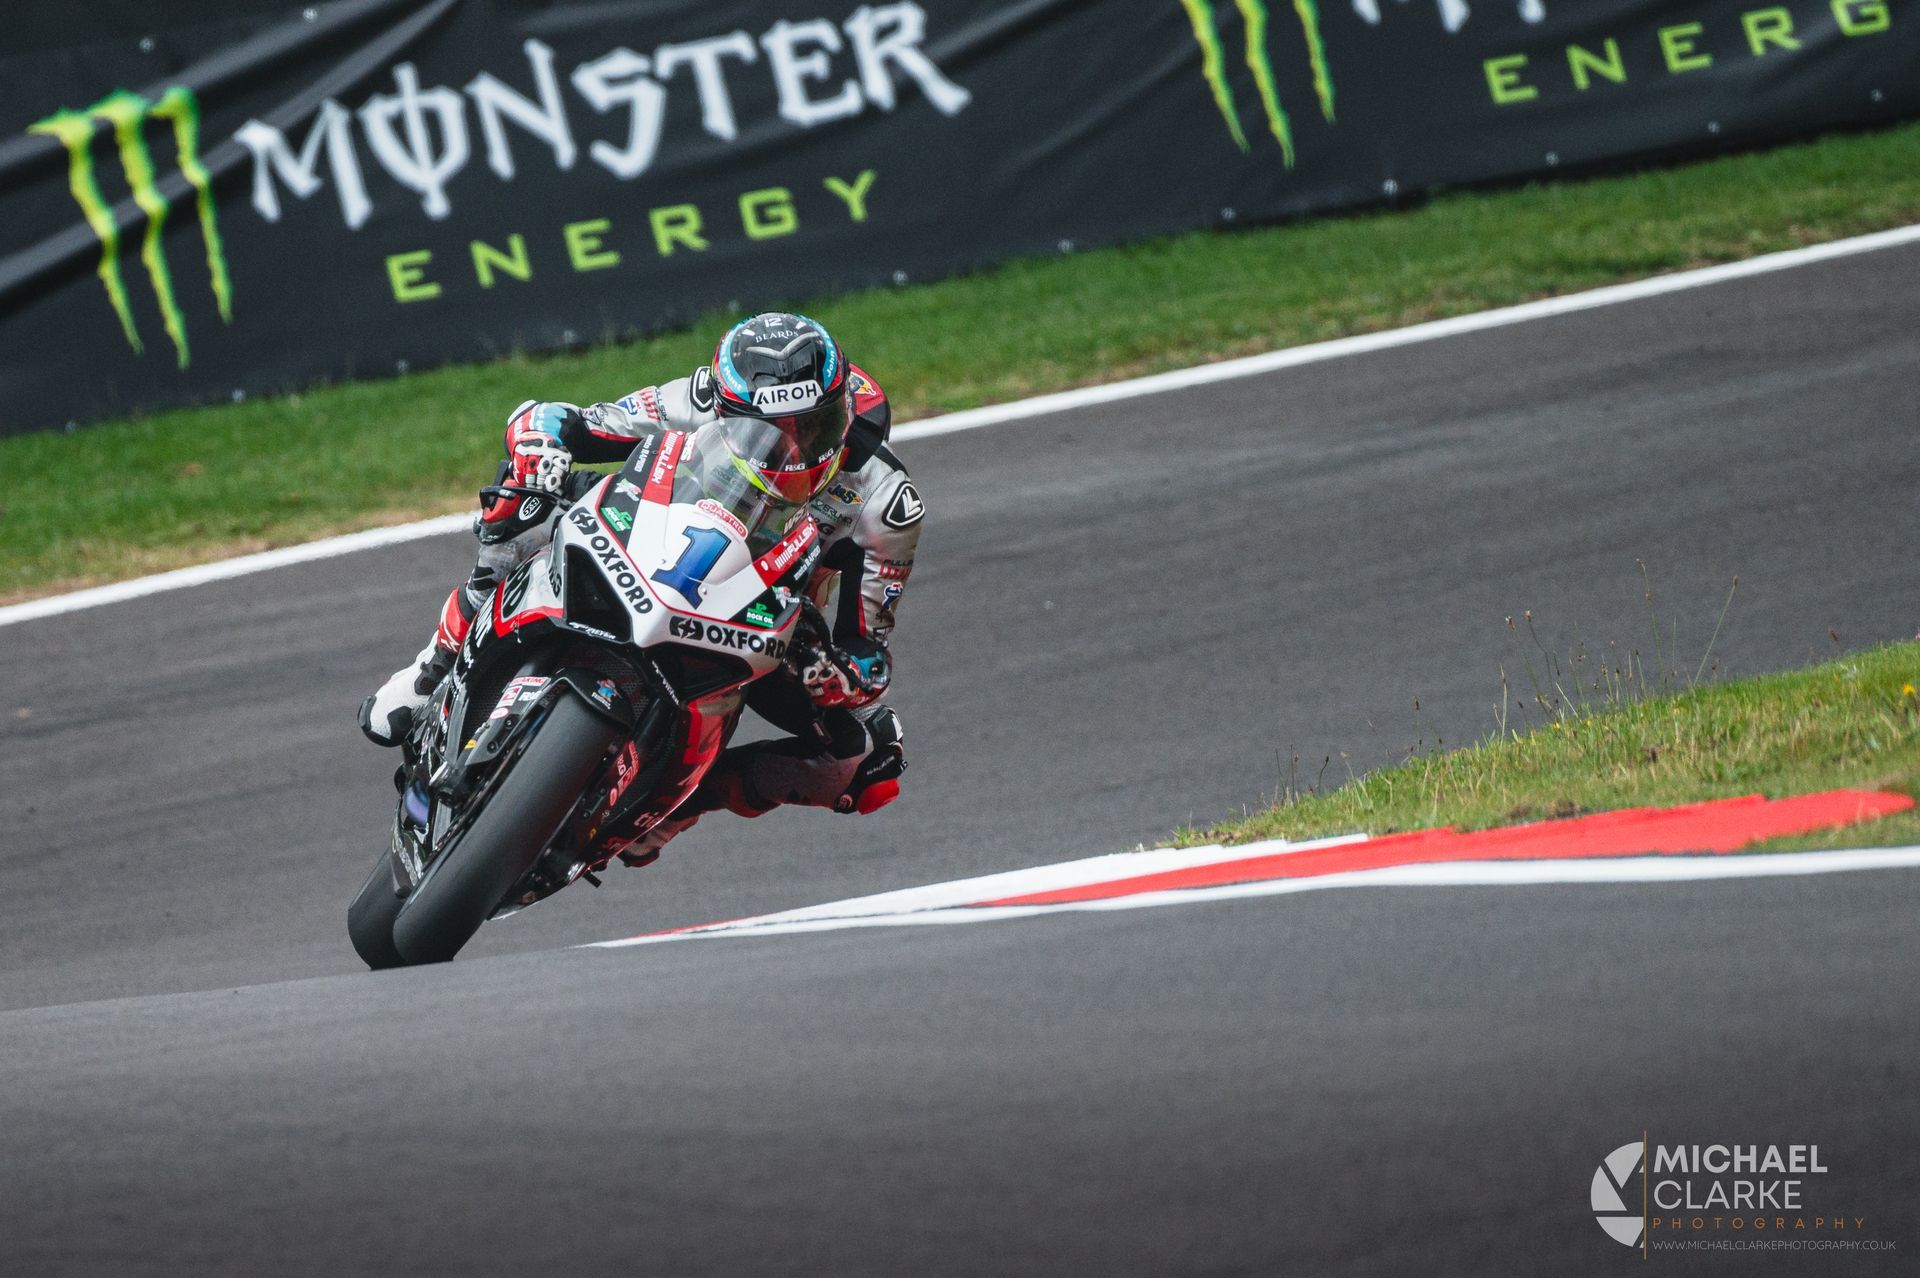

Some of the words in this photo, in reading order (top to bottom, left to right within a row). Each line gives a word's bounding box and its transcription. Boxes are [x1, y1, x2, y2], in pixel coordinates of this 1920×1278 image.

[234, 2, 970, 229] MONSTER
[386, 170, 877, 303] ENERGY
[765, 317, 783, 328] 12
[826, 350, 835, 377] John
[756, 383, 818, 405] AIROH
[785, 463, 806, 472] R&G
[819, 448, 834, 464] R&G
[700, 501, 745, 535] QUATTRO
[591, 535, 654, 614] OXFORD
[650, 526, 732, 610] 1
[746, 612, 763, 621] ROCK
[706, 626, 785, 659] OXFORD
